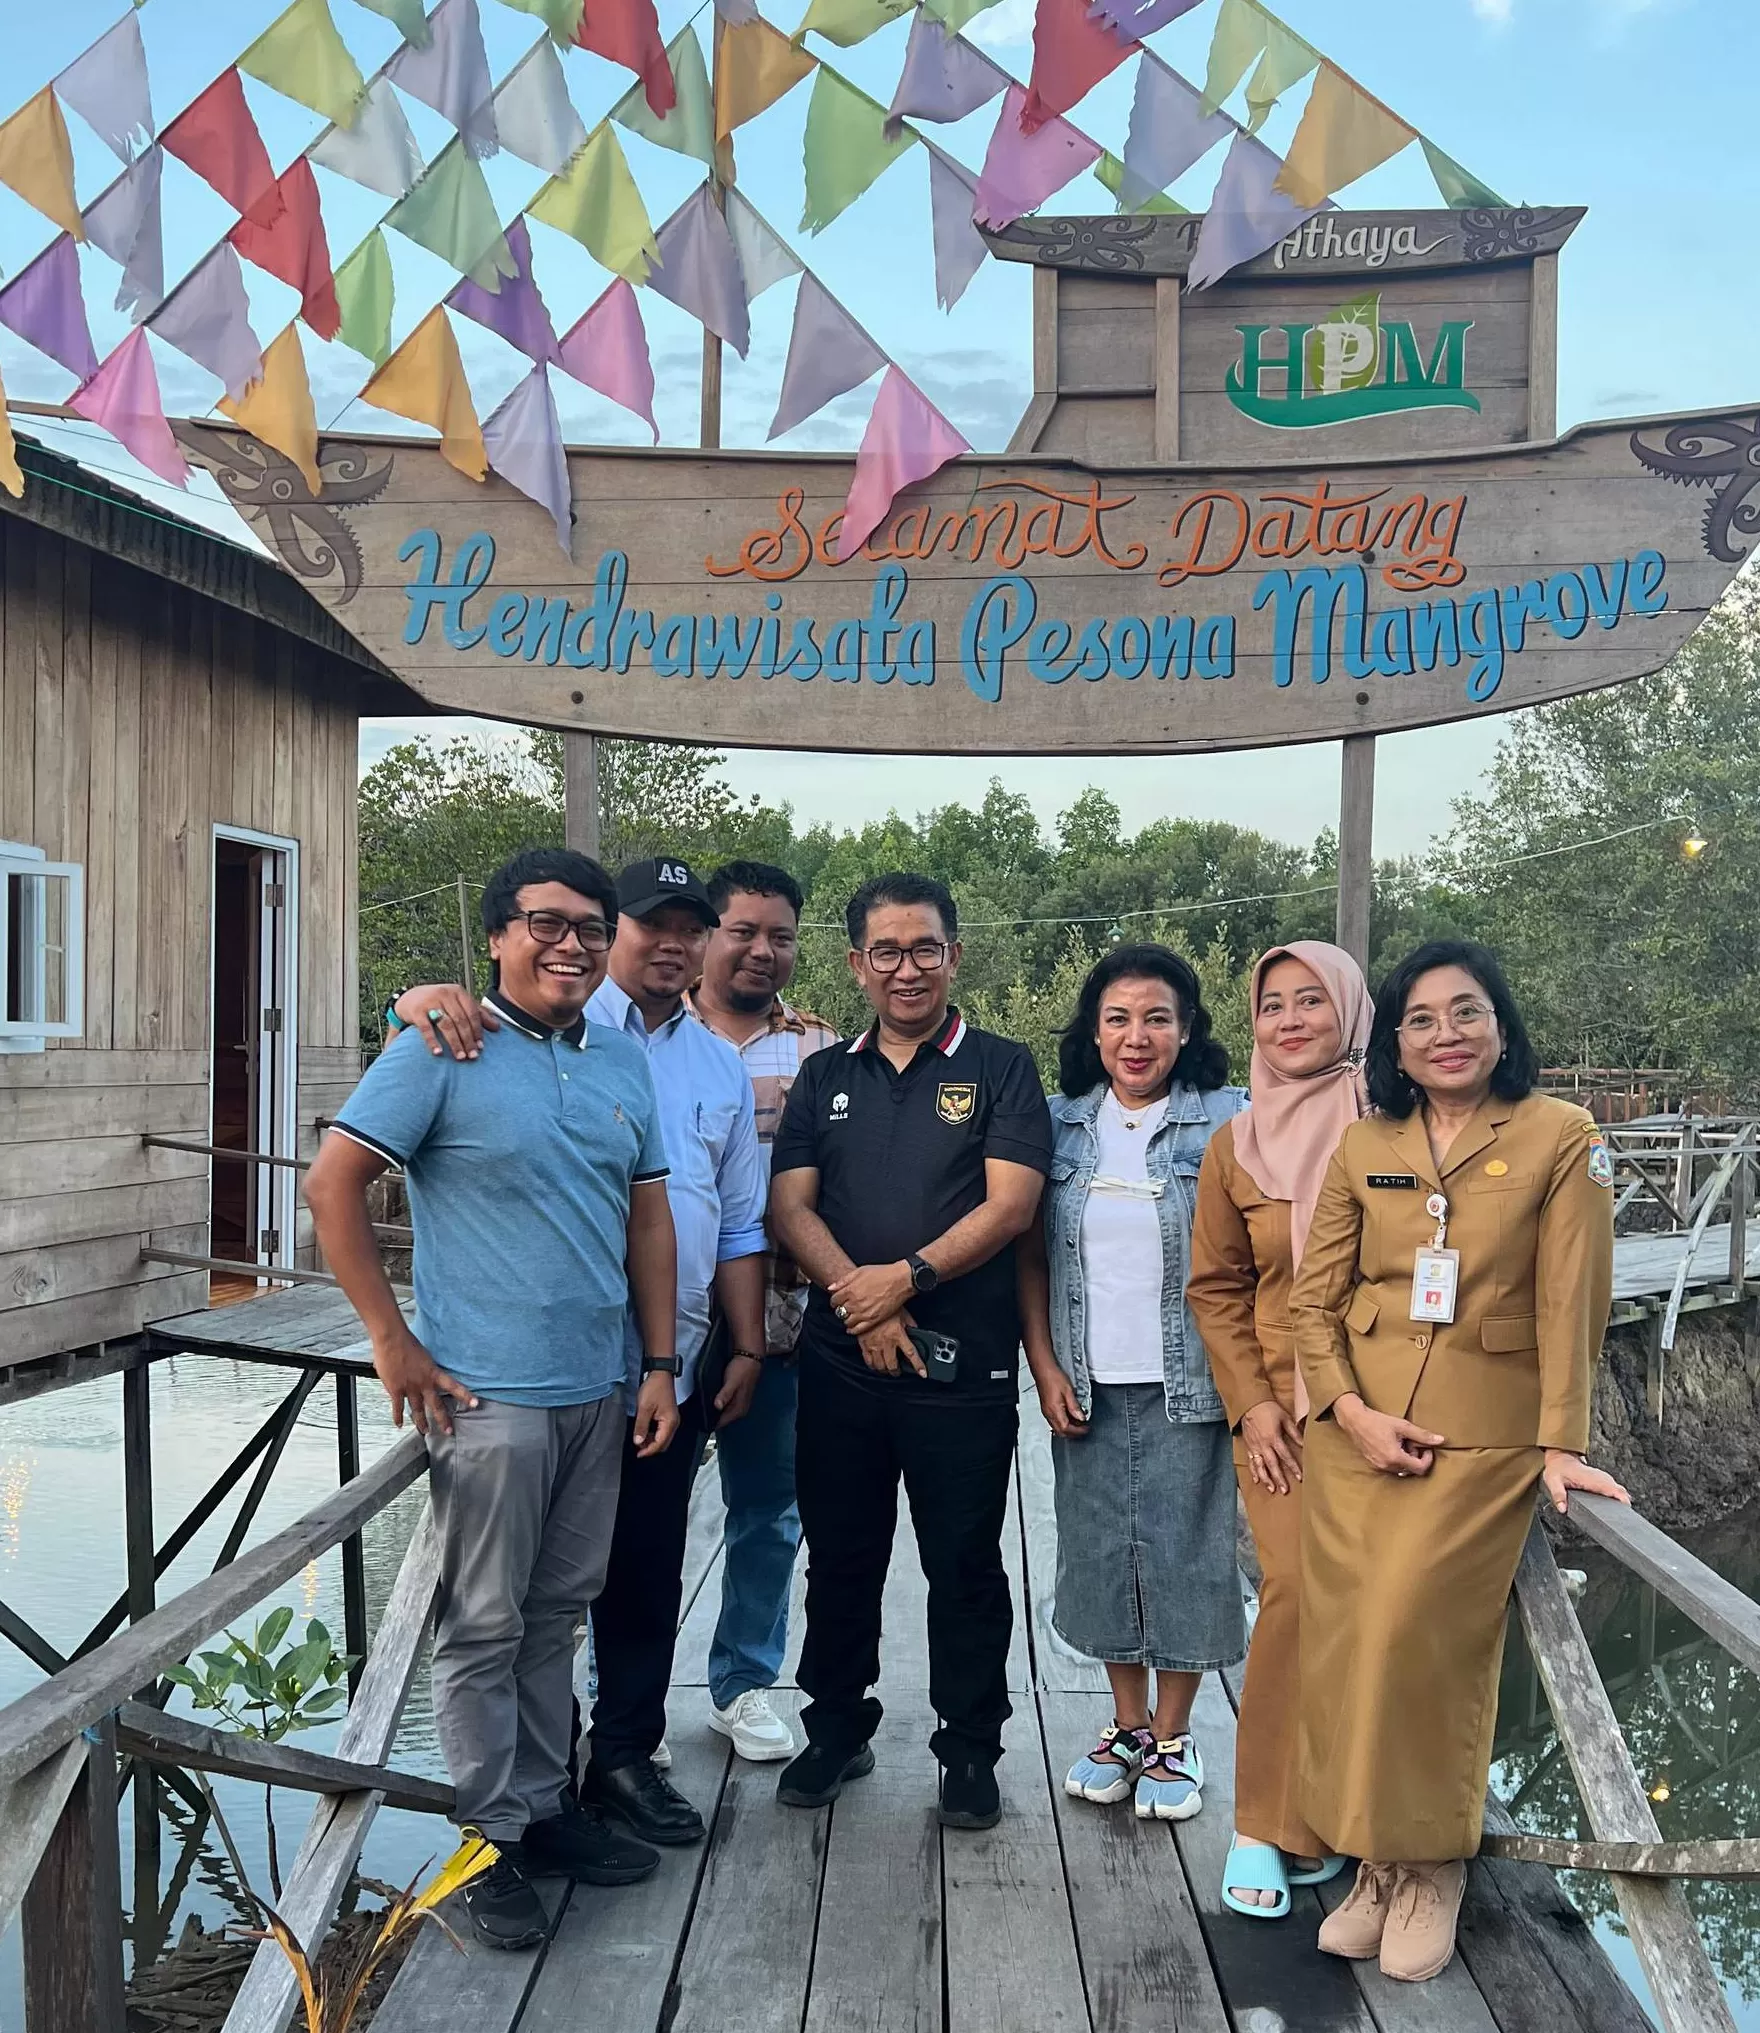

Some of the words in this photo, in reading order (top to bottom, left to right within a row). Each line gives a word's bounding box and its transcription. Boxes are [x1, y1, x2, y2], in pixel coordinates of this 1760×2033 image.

[1274, 216, 1454, 270] Athaya
[1232, 318, 1477, 400] HPM
[705, 479, 1148, 582] Seamat
[1157, 480, 1468, 592] Datang
[400, 528, 936, 686] Hendrawisata
[962, 571, 1238, 703] Pesona
[1253, 549, 1669, 702] Mangrove
[658, 863, 688, 885] AS
[1375, 1177, 1407, 1185] RATIH
